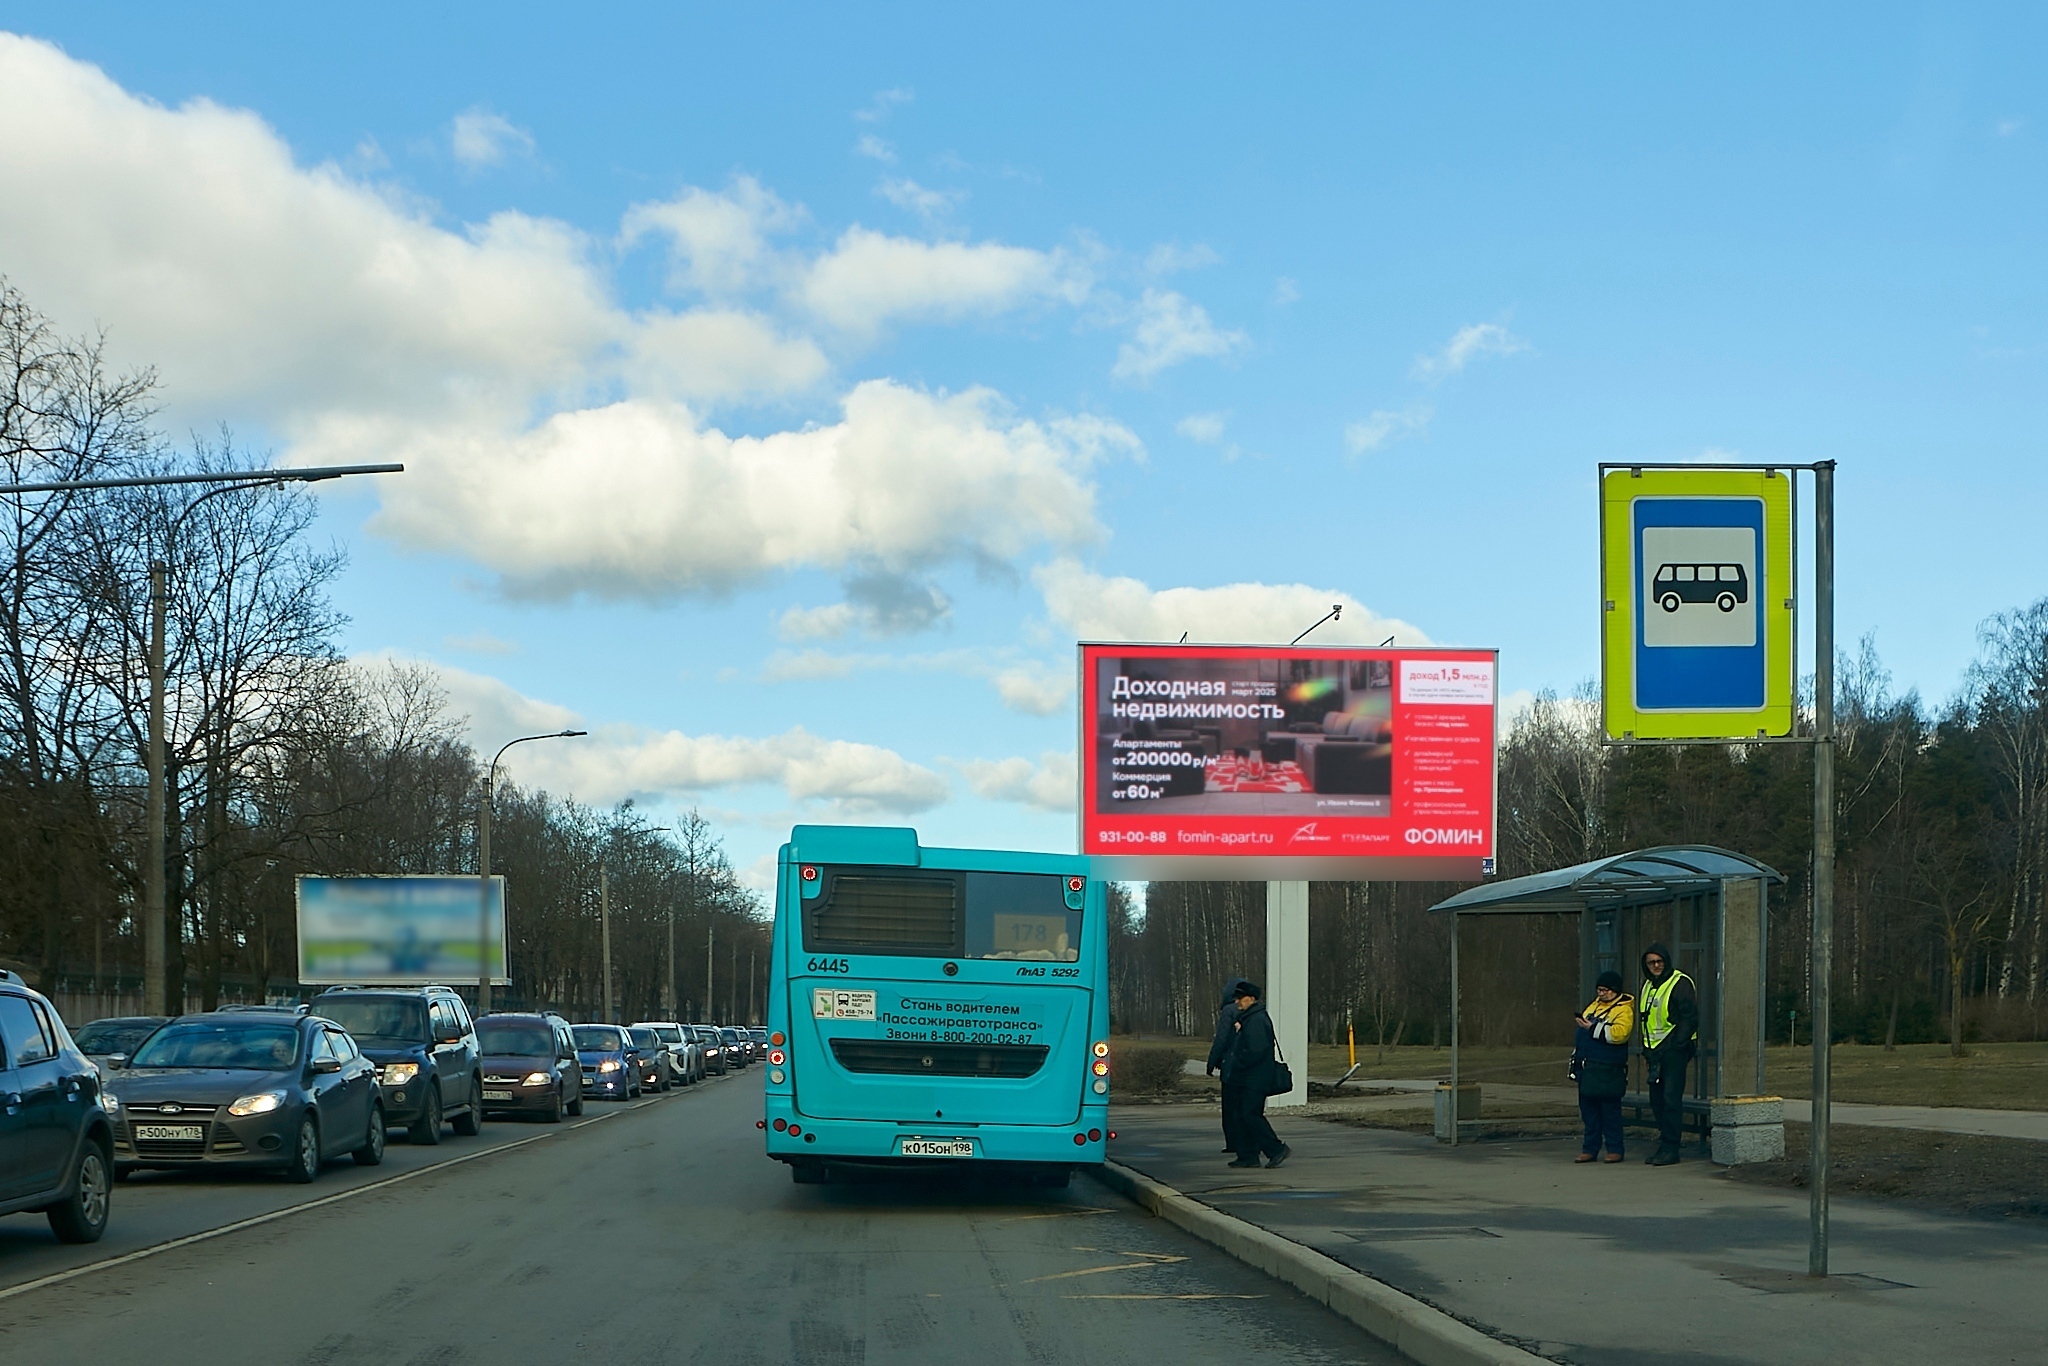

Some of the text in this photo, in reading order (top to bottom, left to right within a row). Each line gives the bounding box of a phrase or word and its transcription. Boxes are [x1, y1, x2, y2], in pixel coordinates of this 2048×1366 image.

[1410, 672, 1440, 680] доход
[1441, 668, 1460, 682] 1,5
[1112, 676, 1226, 699] Доходная
[1232, 688, 1276, 697] март 2025
[1112, 702, 1285, 721] недвижимость
[1112, 740, 1182, 749] Апартаменты
[1112, 757, 1126, 765] от
[1127, 752, 1191, 766] 200000
[1112, 772, 1171, 782] Коммерция
[1112, 790, 1126, 799] от
[1128, 785, 1149, 799] 60
[1099, 830, 1273, 845] 931-00-88 fomin-apart.ru
[1404, 828, 1482, 844] ФОМИН
[1012, 924, 1046, 942] 178
[808, 958, 849, 973] 6445
[1051, 968, 1079, 977] 5292
[900, 998, 1020, 1014] Стань водителем
[876, 1012, 1043, 1031] «Пассажиравтотранса»
[886, 1028, 1032, 1045] Звони 8-800-200-02-87
[140, 1127, 181, 1138] Р500НУ
[905, 1143, 970, 1154] К015ОН 198
